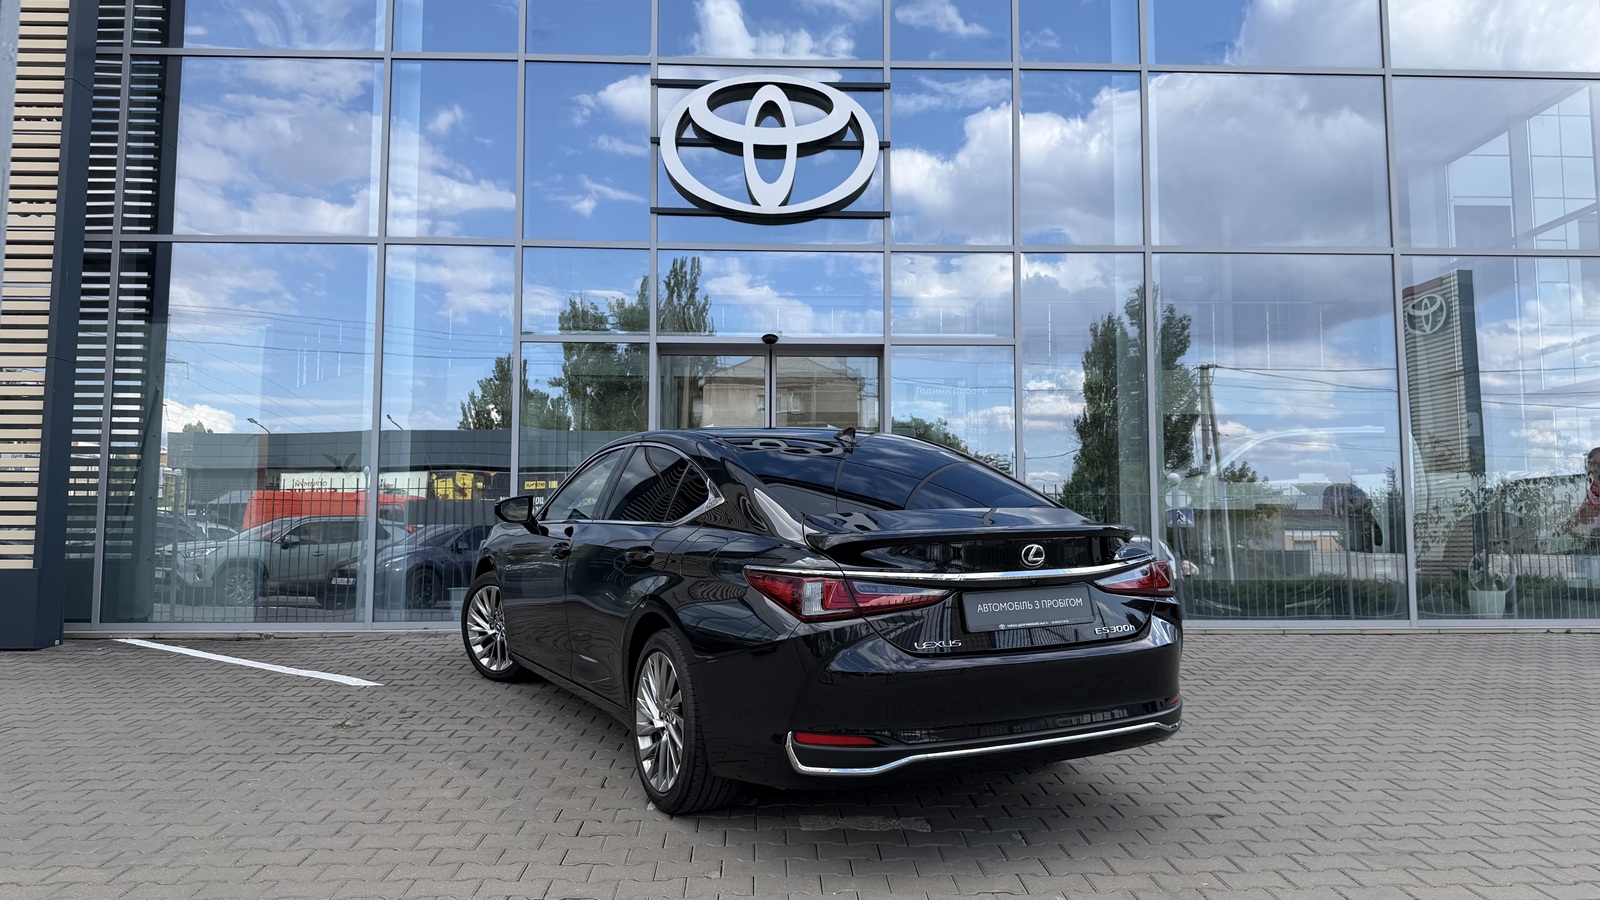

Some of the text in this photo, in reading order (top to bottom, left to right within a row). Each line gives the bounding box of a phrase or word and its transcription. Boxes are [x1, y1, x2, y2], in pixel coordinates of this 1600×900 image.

[916, 386, 951, 396] Години
[977, 601, 1033, 613] АВТОМОБІЛЬ
[1041, 597, 1084, 609] ПРОБІГОМ
[1094, 624, 1135, 635] ES300h
[914, 639, 962, 650] LEXUS
